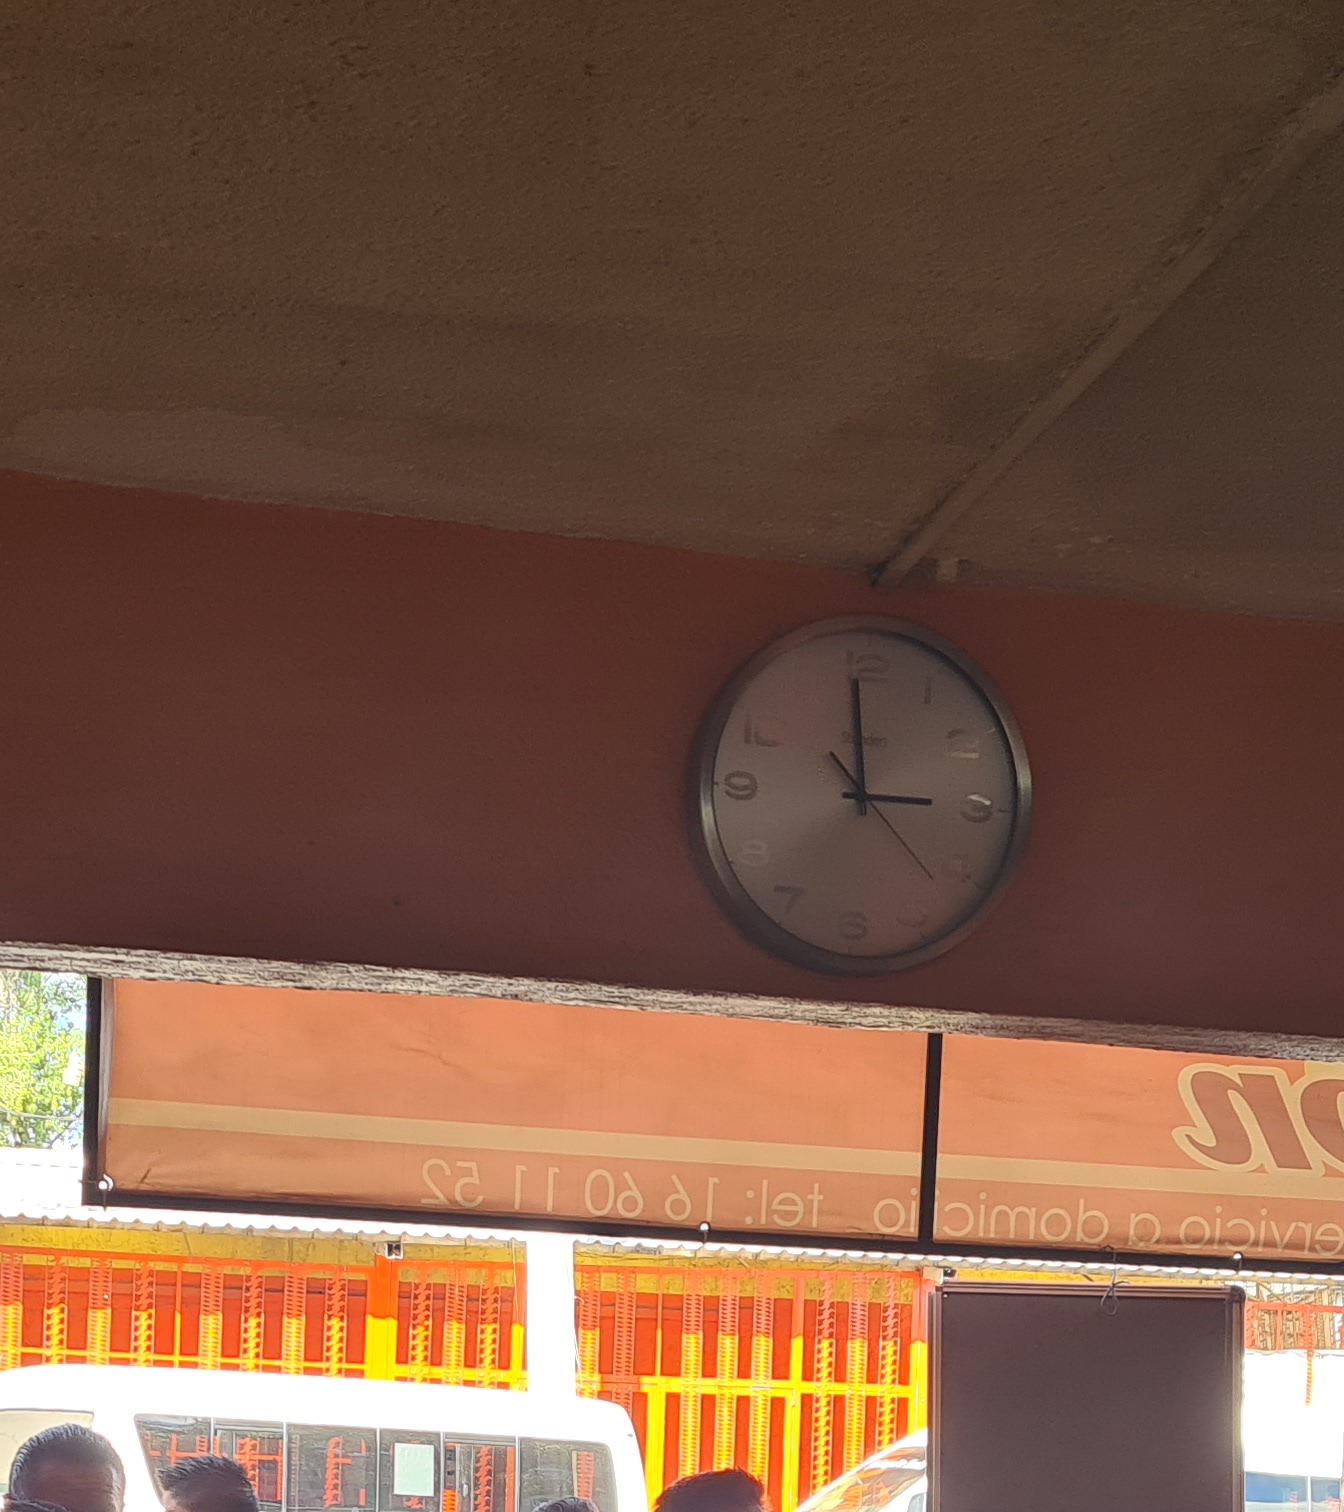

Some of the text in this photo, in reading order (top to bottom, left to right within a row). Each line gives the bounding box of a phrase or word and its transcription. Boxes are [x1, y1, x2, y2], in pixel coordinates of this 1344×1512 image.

[846, 650, 888, 682] 12
[724, 770, 757, 801] 9
[773, 884, 807, 915] 7
